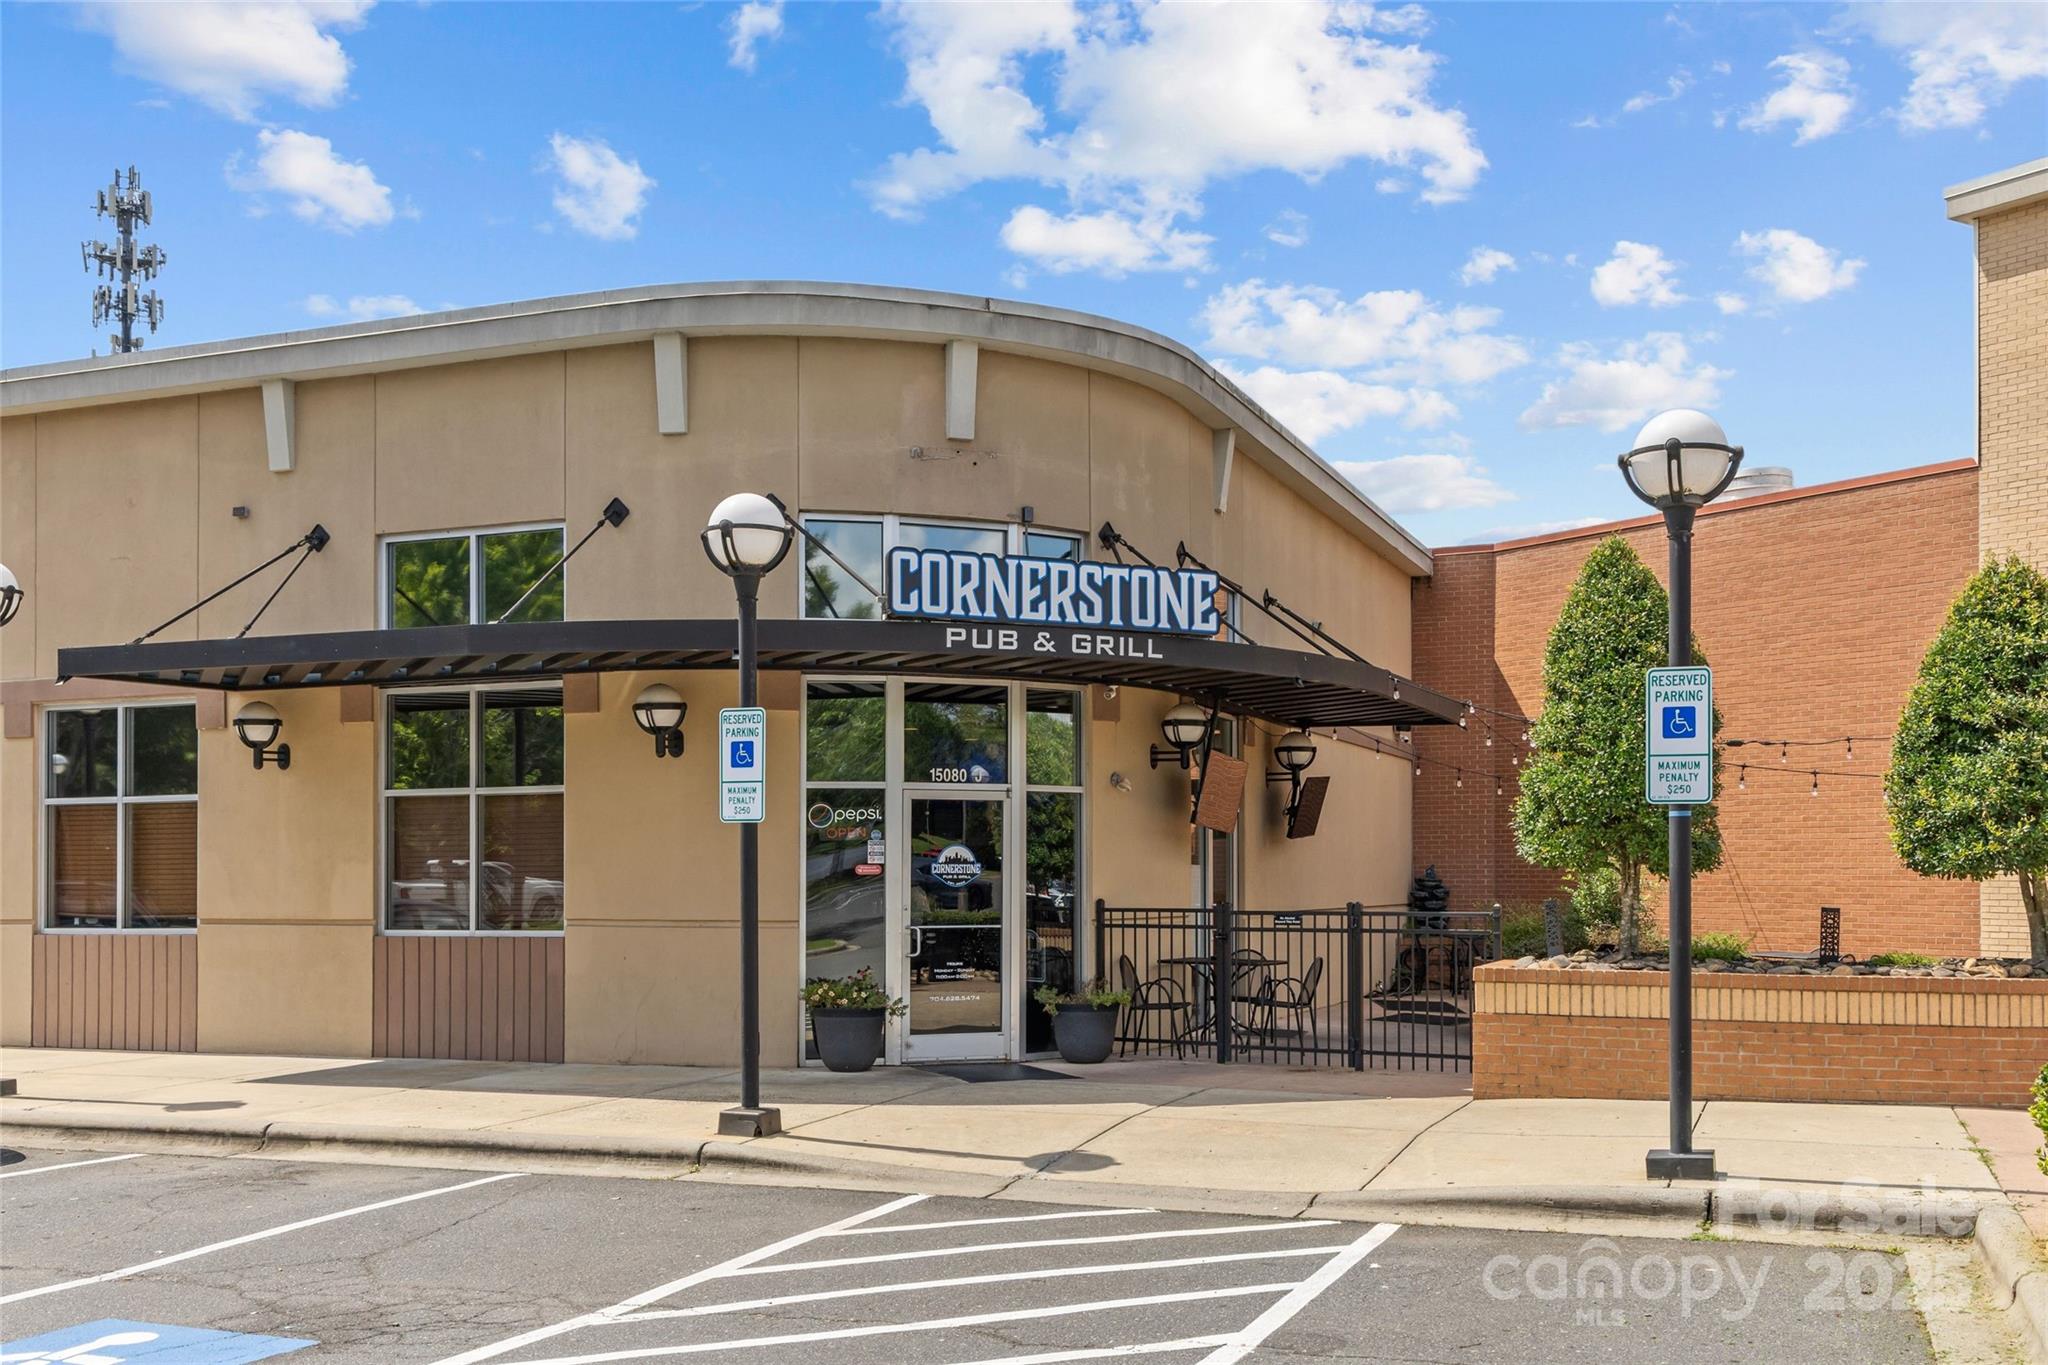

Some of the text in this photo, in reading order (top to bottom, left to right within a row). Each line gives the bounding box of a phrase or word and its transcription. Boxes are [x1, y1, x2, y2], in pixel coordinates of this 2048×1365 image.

[890, 549, 1218, 633] CORNERSTONE
[946, 627, 1163, 659] PUB & GRILL
[1651, 674, 1707, 686] RESERVED
[1655, 690, 1703, 702] PARKING
[723, 714, 761, 724] RESERVED
[725, 727, 759, 737] PARKING
[1658, 761, 1700, 770] MAXIMUM
[929, 767, 967, 782] 15080
[1659, 773, 1699, 782] PENALTY
[728, 786, 757, 794] MAXIMUM
[1667, 784, 1691, 794] $250
[728, 796, 755, 804] PENALTY
[734, 806, 750, 815] $250
[826, 827, 867, 839] OPEN
[932, 863, 981, 874] CORNERSTONE
